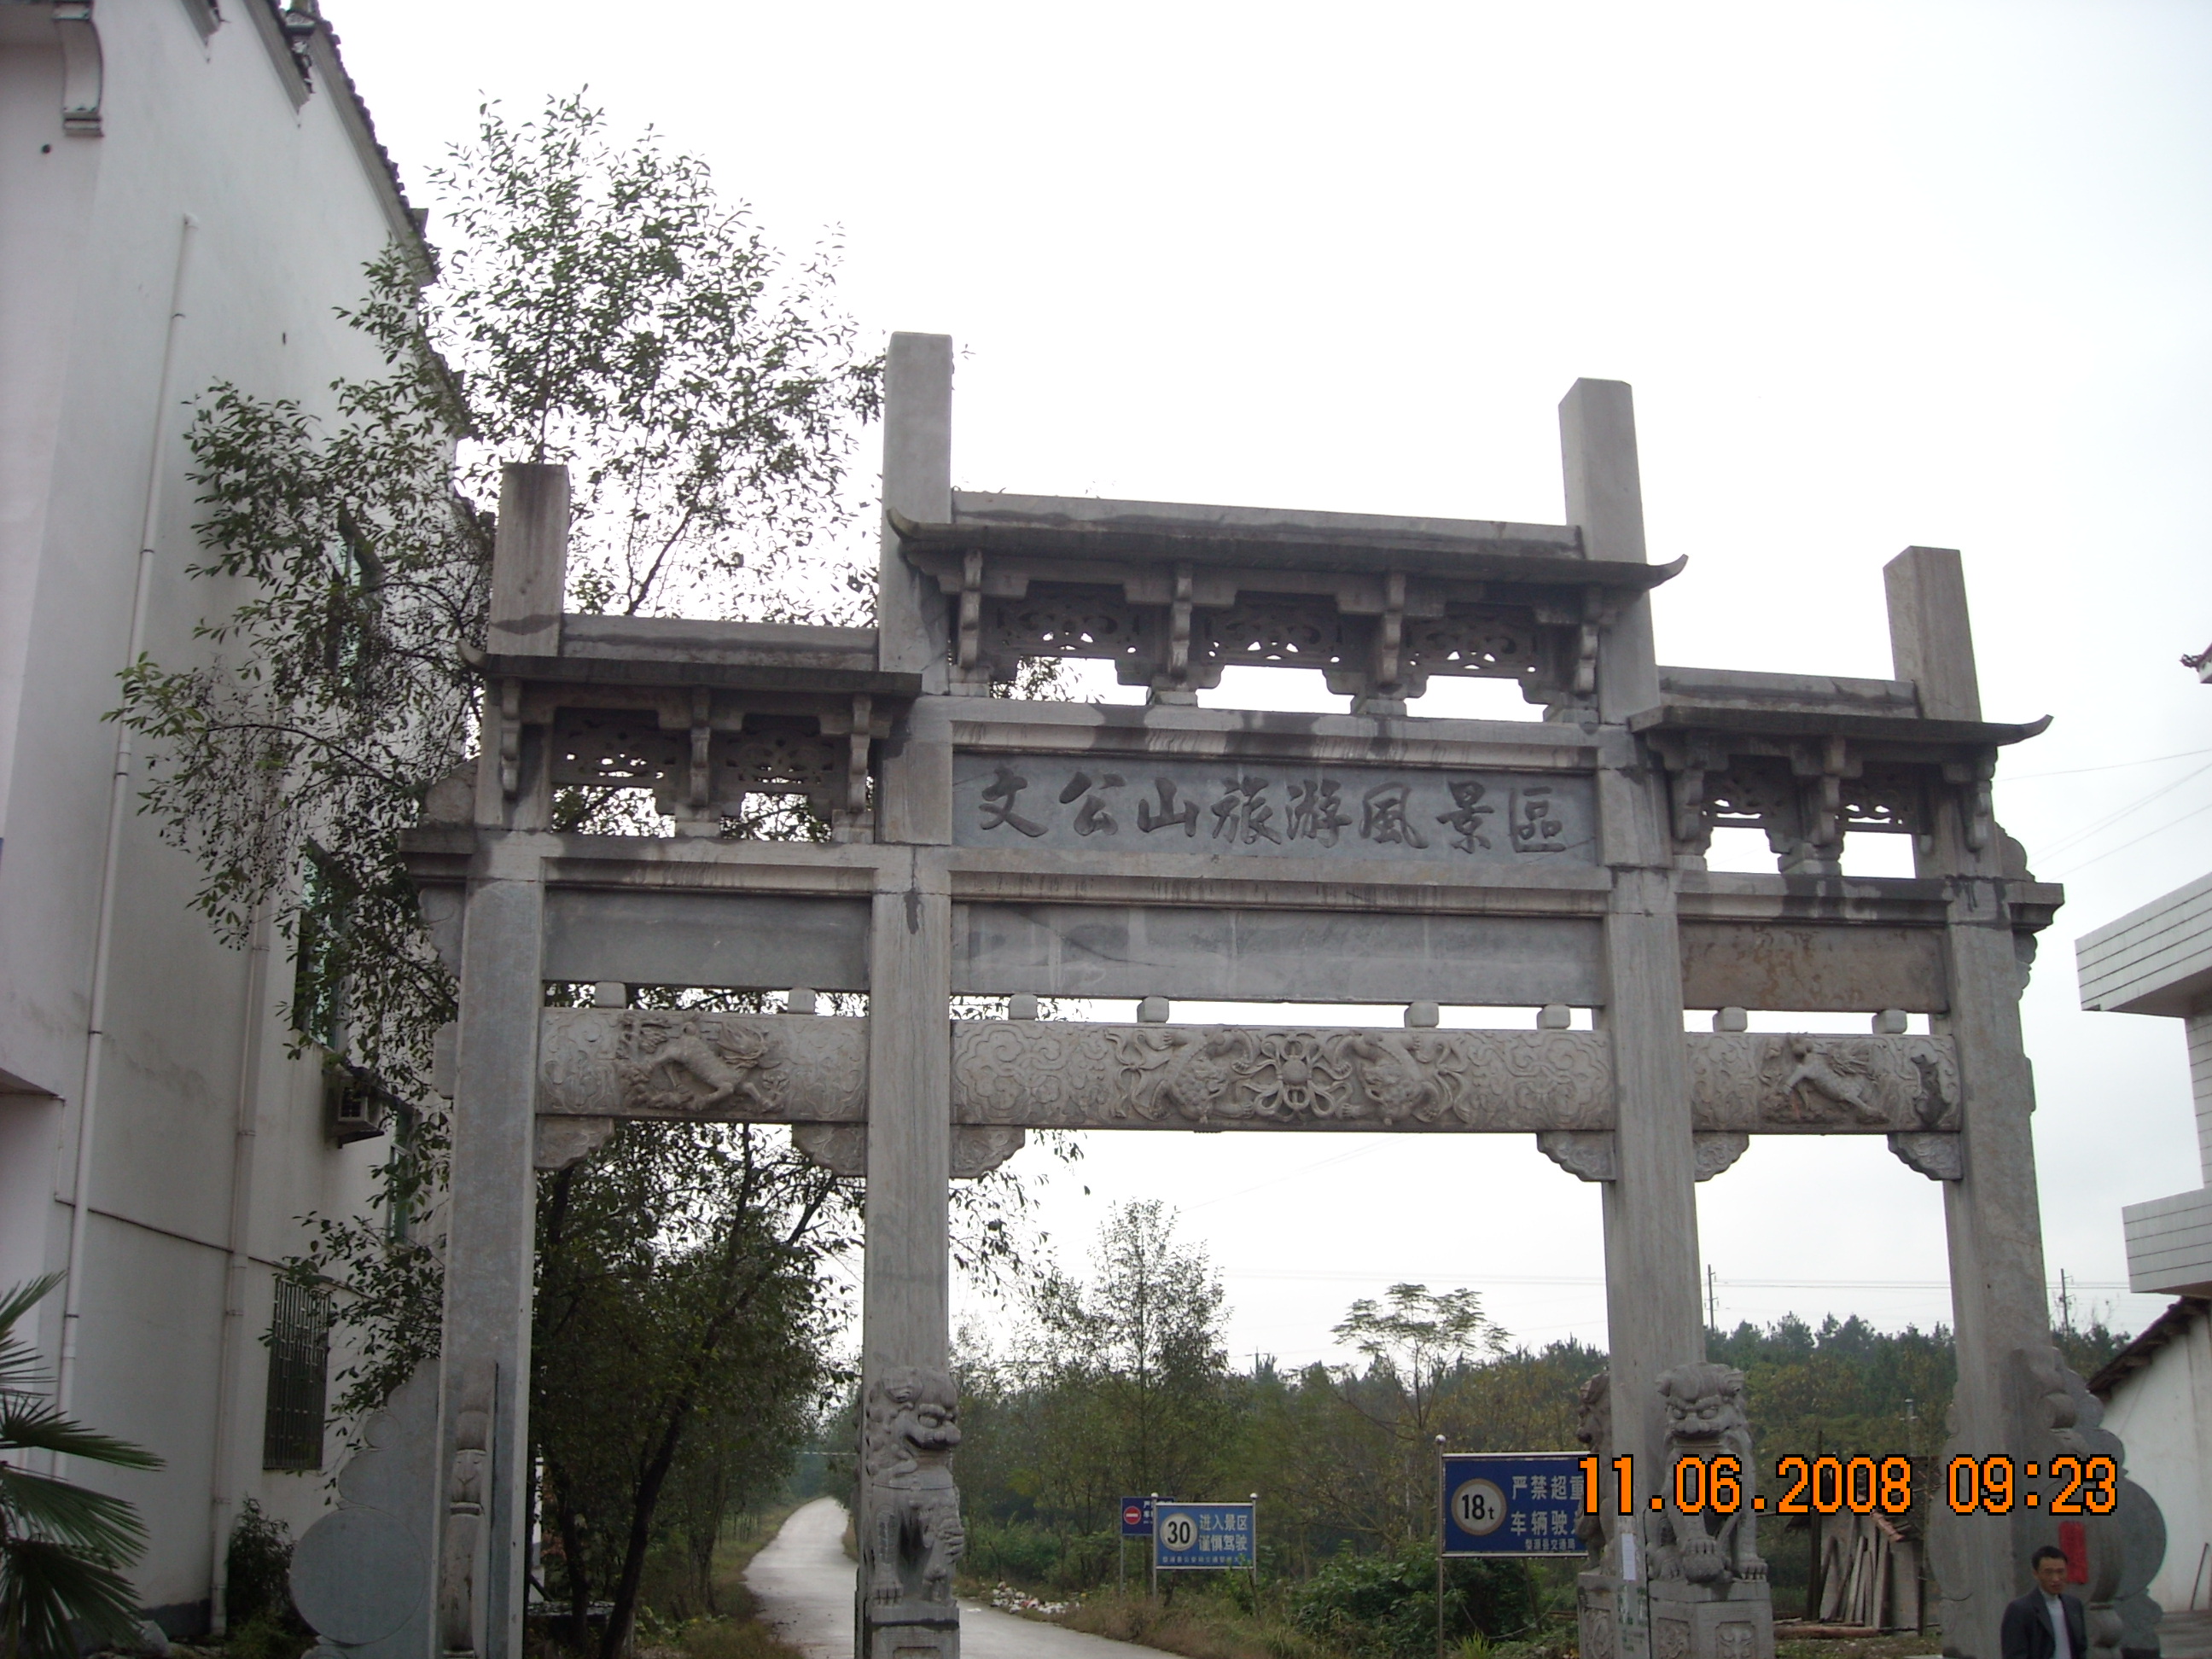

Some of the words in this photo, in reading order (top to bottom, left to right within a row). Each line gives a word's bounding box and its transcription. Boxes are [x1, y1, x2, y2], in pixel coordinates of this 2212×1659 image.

[1511, 1475, 1584, 1500] 严禁超重
[1167, 1521, 1190, 1545] 30
[1199, 1514, 1248, 1532] 进入景区
[1511, 1510, 1577, 1536] 车辆驶
[1198, 1534, 1248, 1551] 谨慎驾驶
